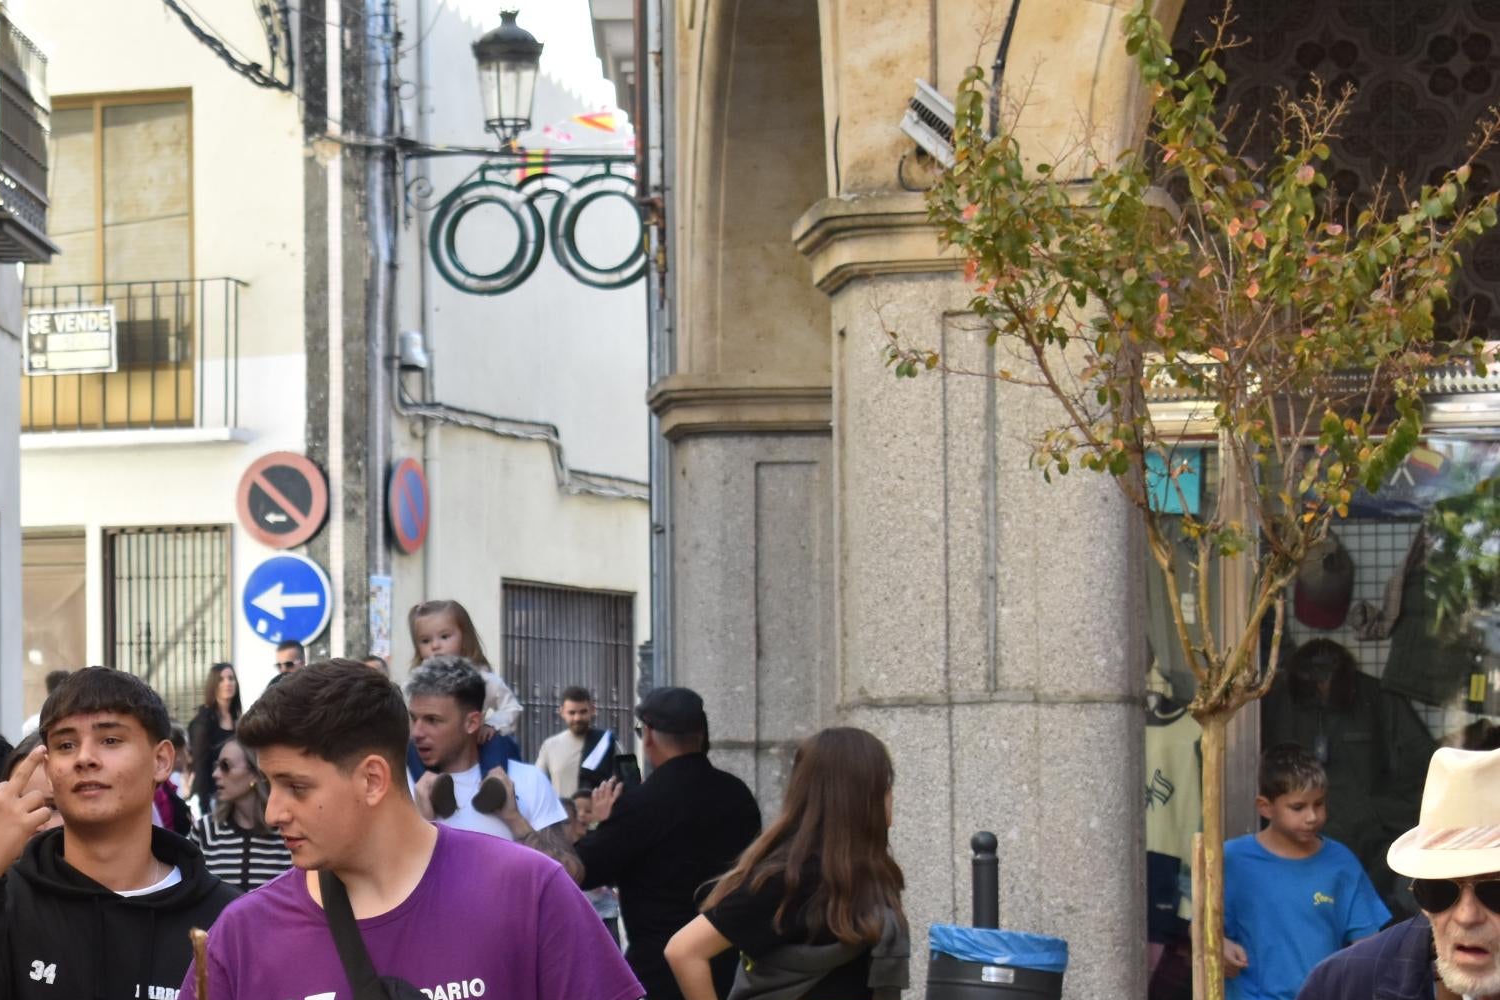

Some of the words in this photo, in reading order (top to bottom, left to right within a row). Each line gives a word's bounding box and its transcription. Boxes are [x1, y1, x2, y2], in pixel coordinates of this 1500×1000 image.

[29, 314, 51, 334] SE
[53, 311, 110, 333] VENDE
[29, 959, 57, 984] 34
